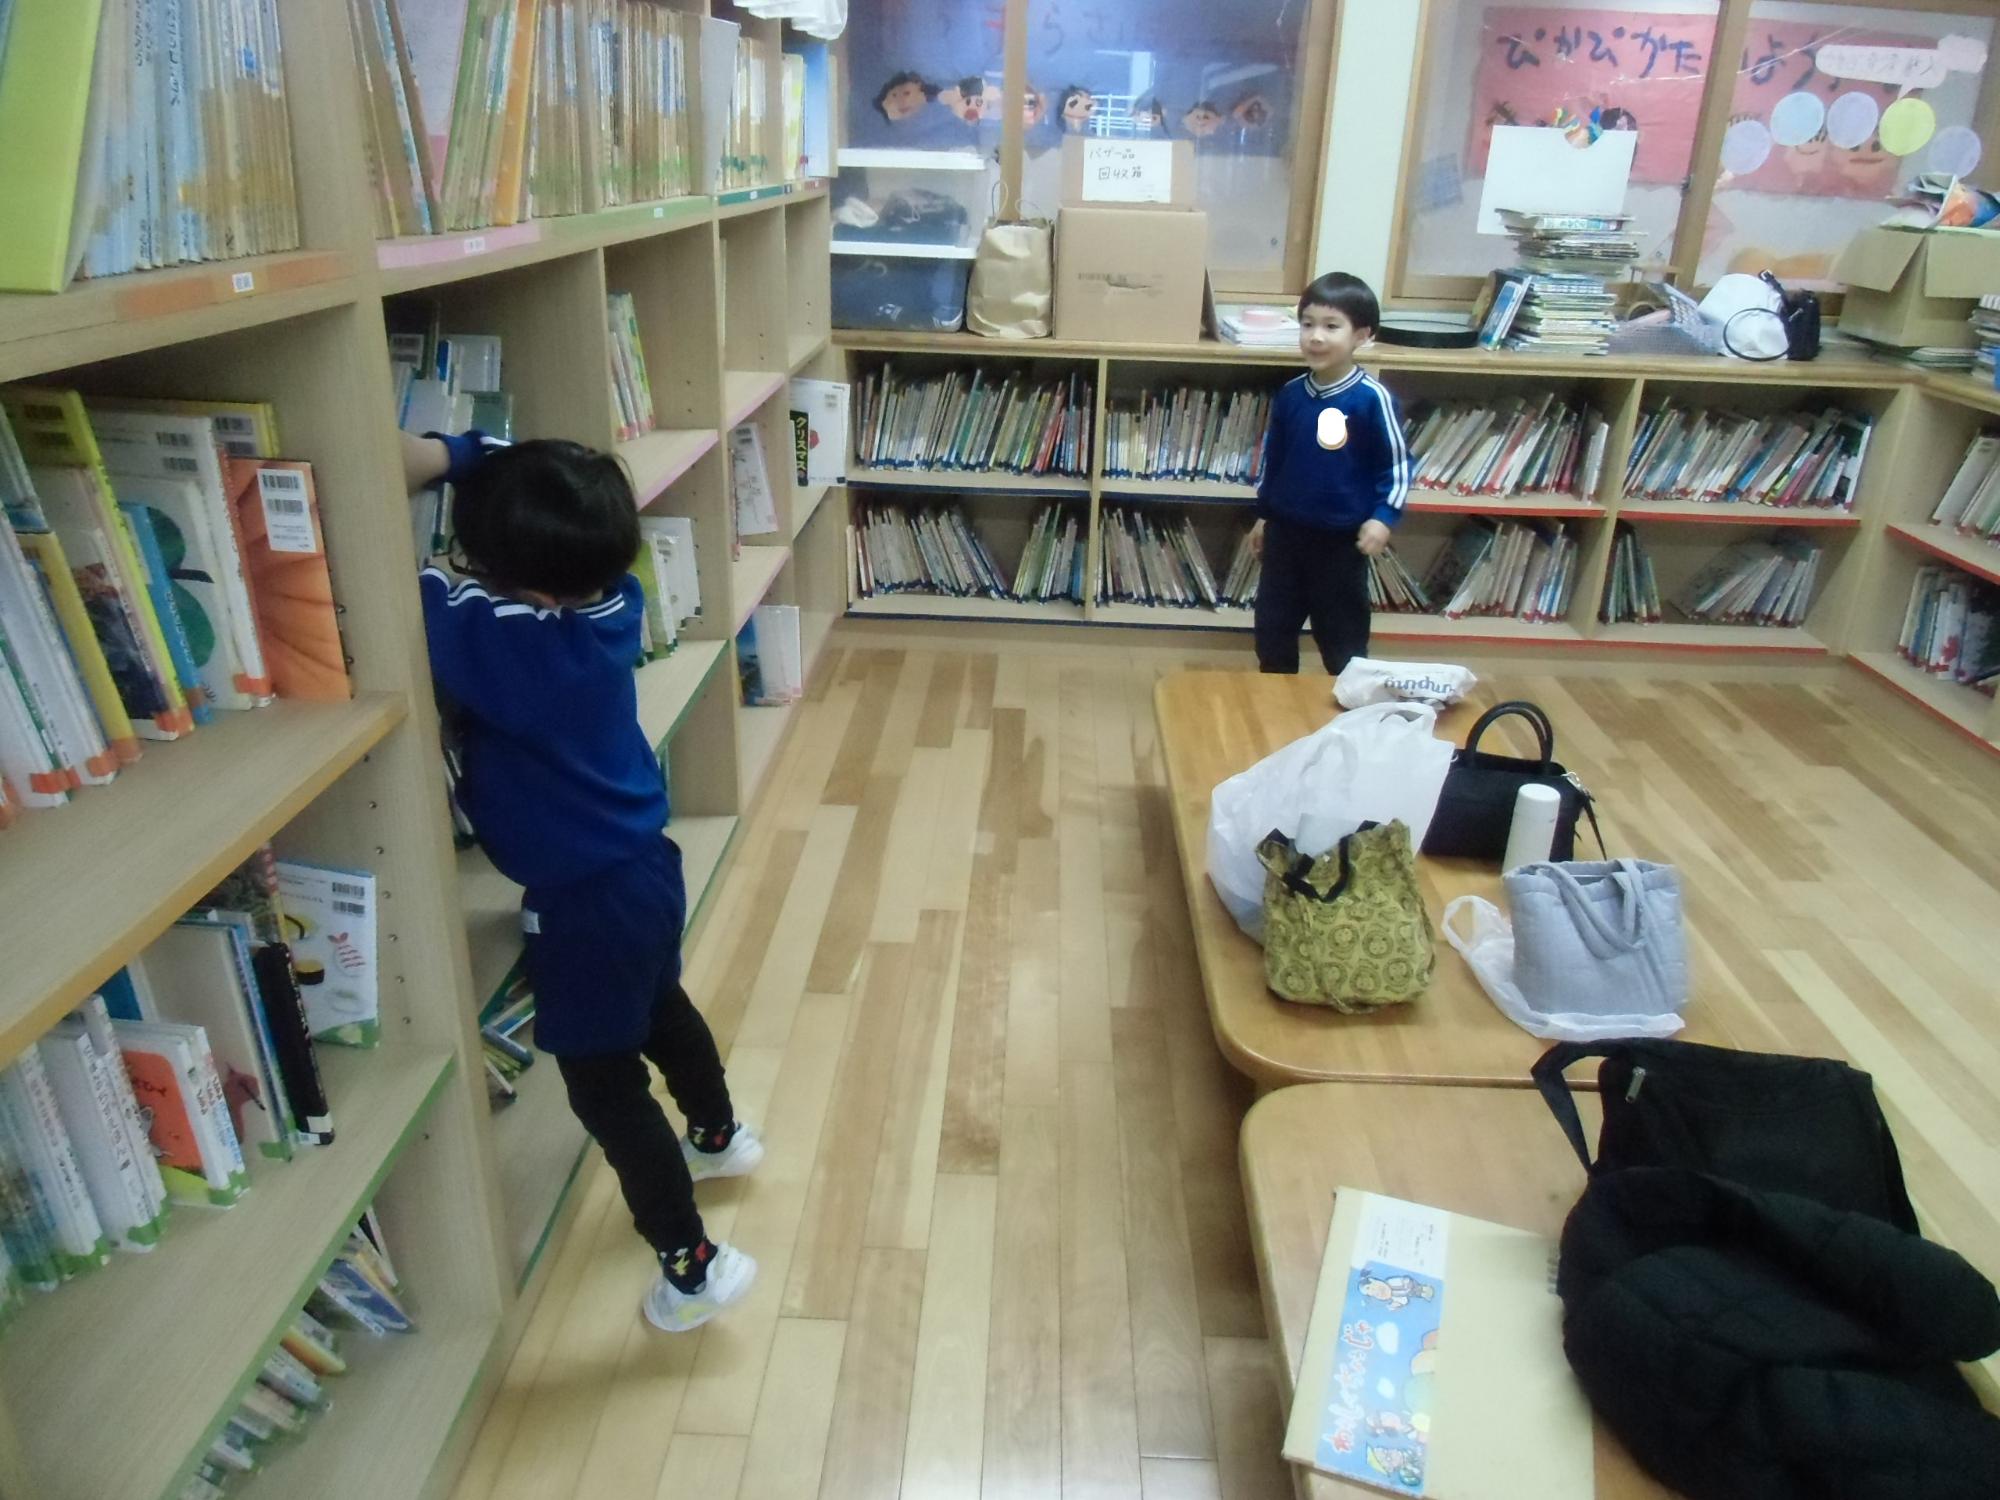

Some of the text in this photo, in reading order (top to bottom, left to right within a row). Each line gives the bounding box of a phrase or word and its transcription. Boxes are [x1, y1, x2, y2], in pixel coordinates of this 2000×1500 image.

[1089, 147, 1135, 159] バザー品
[1098, 166, 1142, 180] 回収箱
[795, 416, 807, 471] クリスマス
